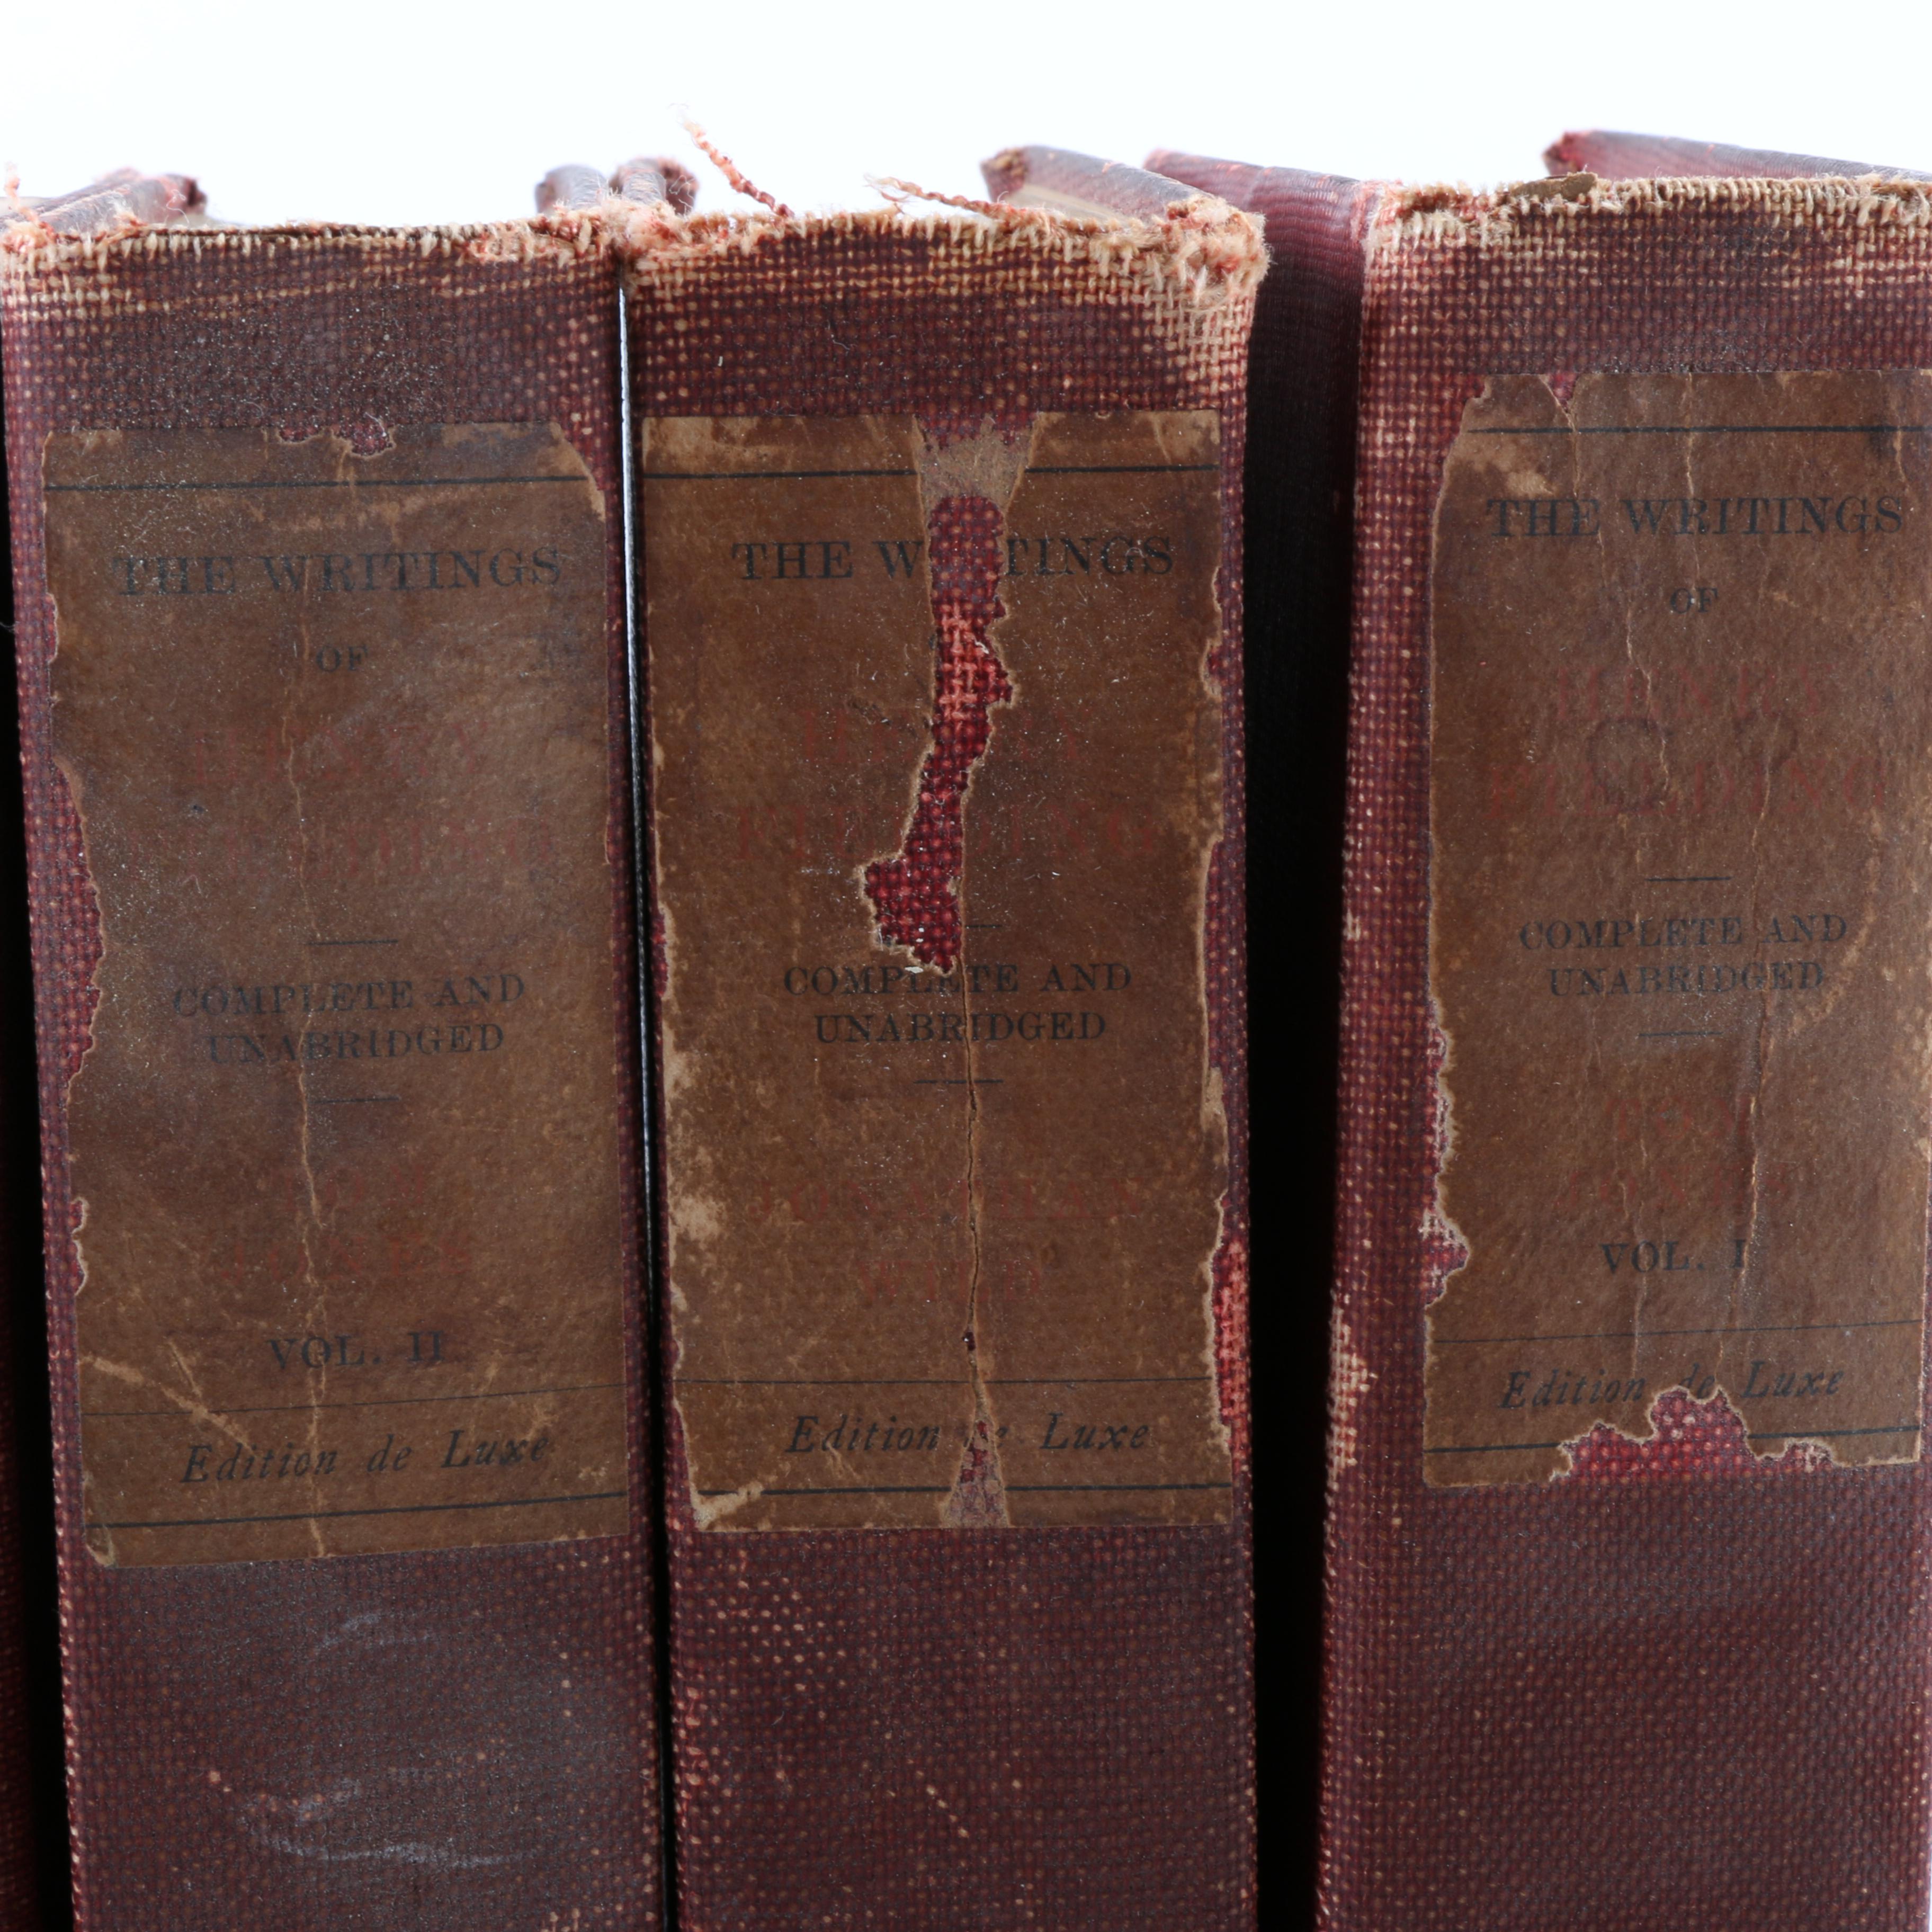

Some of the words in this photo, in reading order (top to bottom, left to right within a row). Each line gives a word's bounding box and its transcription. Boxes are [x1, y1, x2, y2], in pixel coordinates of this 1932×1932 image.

[1486, 497, 1600, 537] THE
[1621, 494, 1903, 534] WRITINGS
[112, 555, 236, 596] THE
[257, 546, 562, 594] WRITINGS
[732, 540, 853, 580] THE
[872, 535, 1174, 577] WTINGS
[1669, 586, 1719, 614] OF
[318, 643, 369, 674] OF
[1519, 916, 1744, 951] COMPLETE
[1758, 913, 1848, 944] AND
[172, 980, 414, 1018] COMPLETE
[431, 972, 525, 1007] AND
[1040, 962, 1132, 992] AND
[1547, 960, 1825, 998] UNABRIDGED
[204, 1022, 505, 1065] UNABRIDGED
[814, 1011, 1107, 1043] UNABRIDGED
[1598, 1240, 1704, 1275] VOL.
[1731, 1238, 1747, 1268] I
[267, 1335, 380, 1369] VOL.
[407, 1329, 444, 1364] II
[1499, 1369, 1647, 1410] Edition
[1740, 1360, 1846, 1400] Luxe
[785, 1415, 940, 1453] Edition
[1040, 1411, 1150, 1451] Luxe
[180, 1444, 337, 1483] Edition
[368, 1434, 412, 1472] de
[441, 1428, 549, 1469] Luxe
